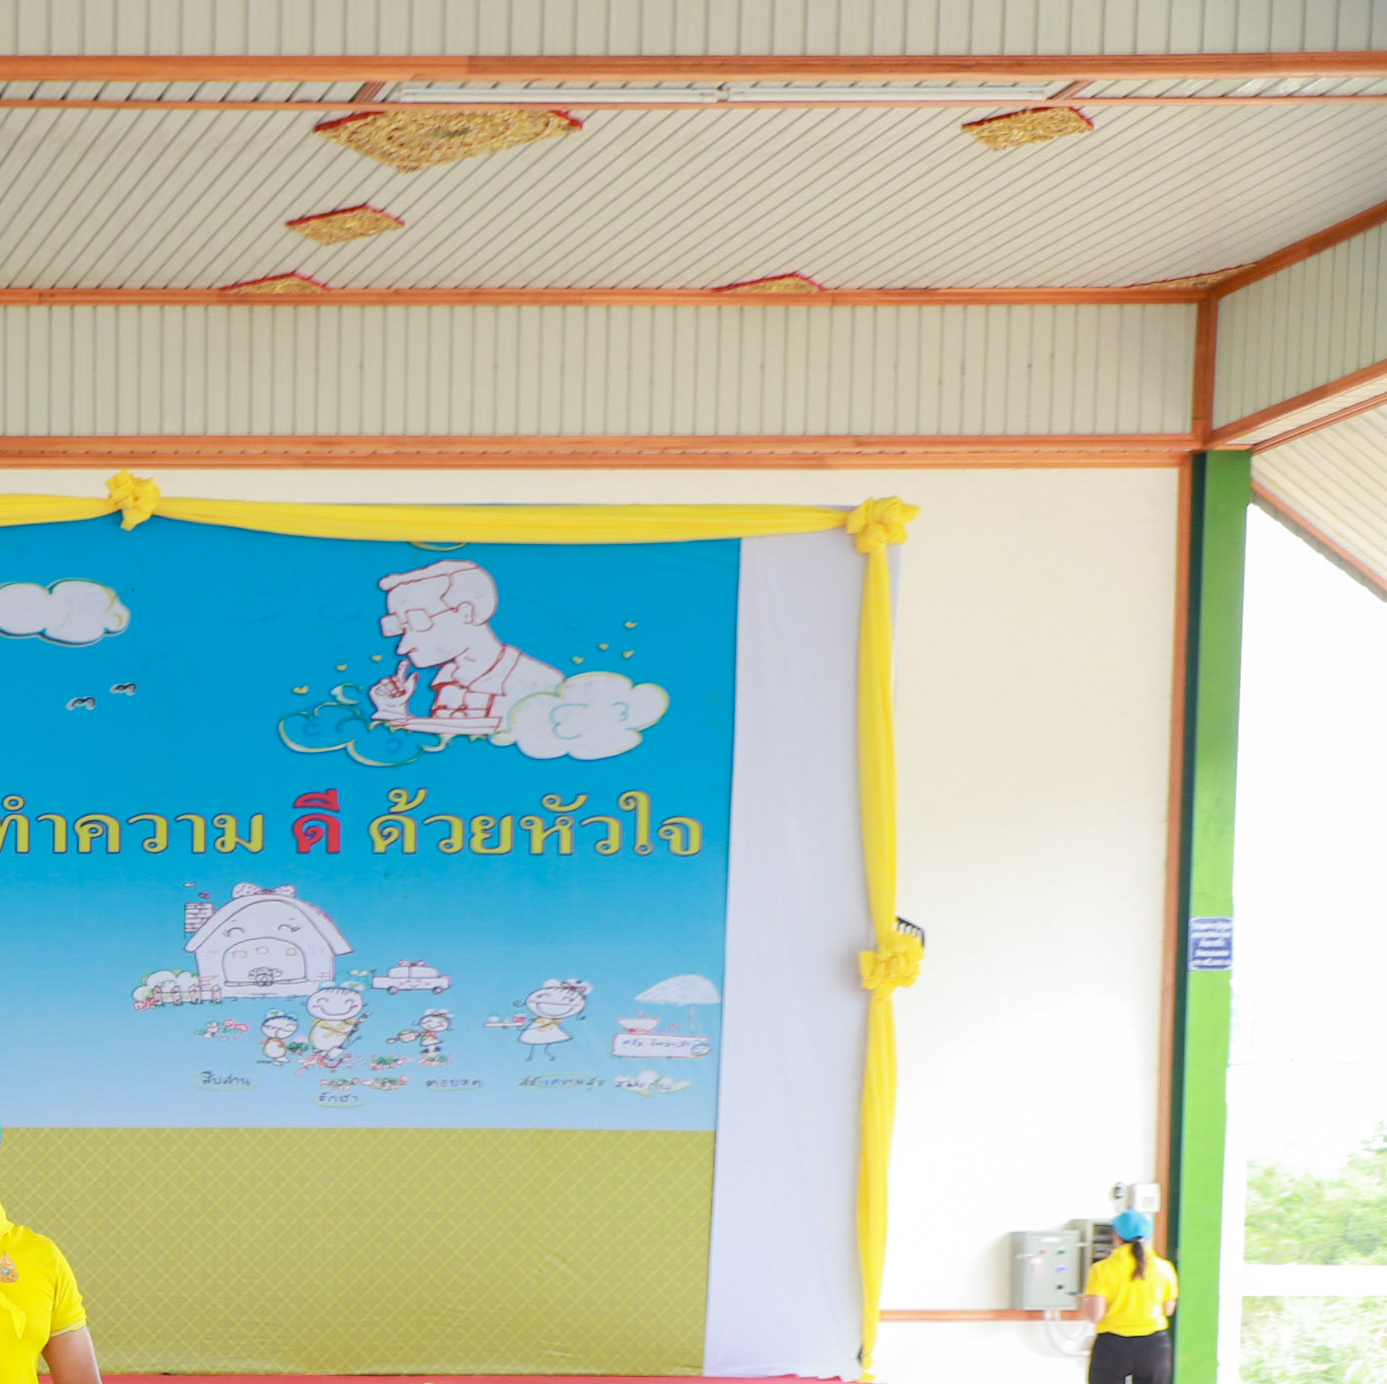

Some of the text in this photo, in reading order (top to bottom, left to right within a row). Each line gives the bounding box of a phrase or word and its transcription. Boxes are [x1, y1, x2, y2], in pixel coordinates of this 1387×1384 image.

[290, 788, 344, 856] ดี
[366, 787, 704, 858] ด้วยหัวใจ
